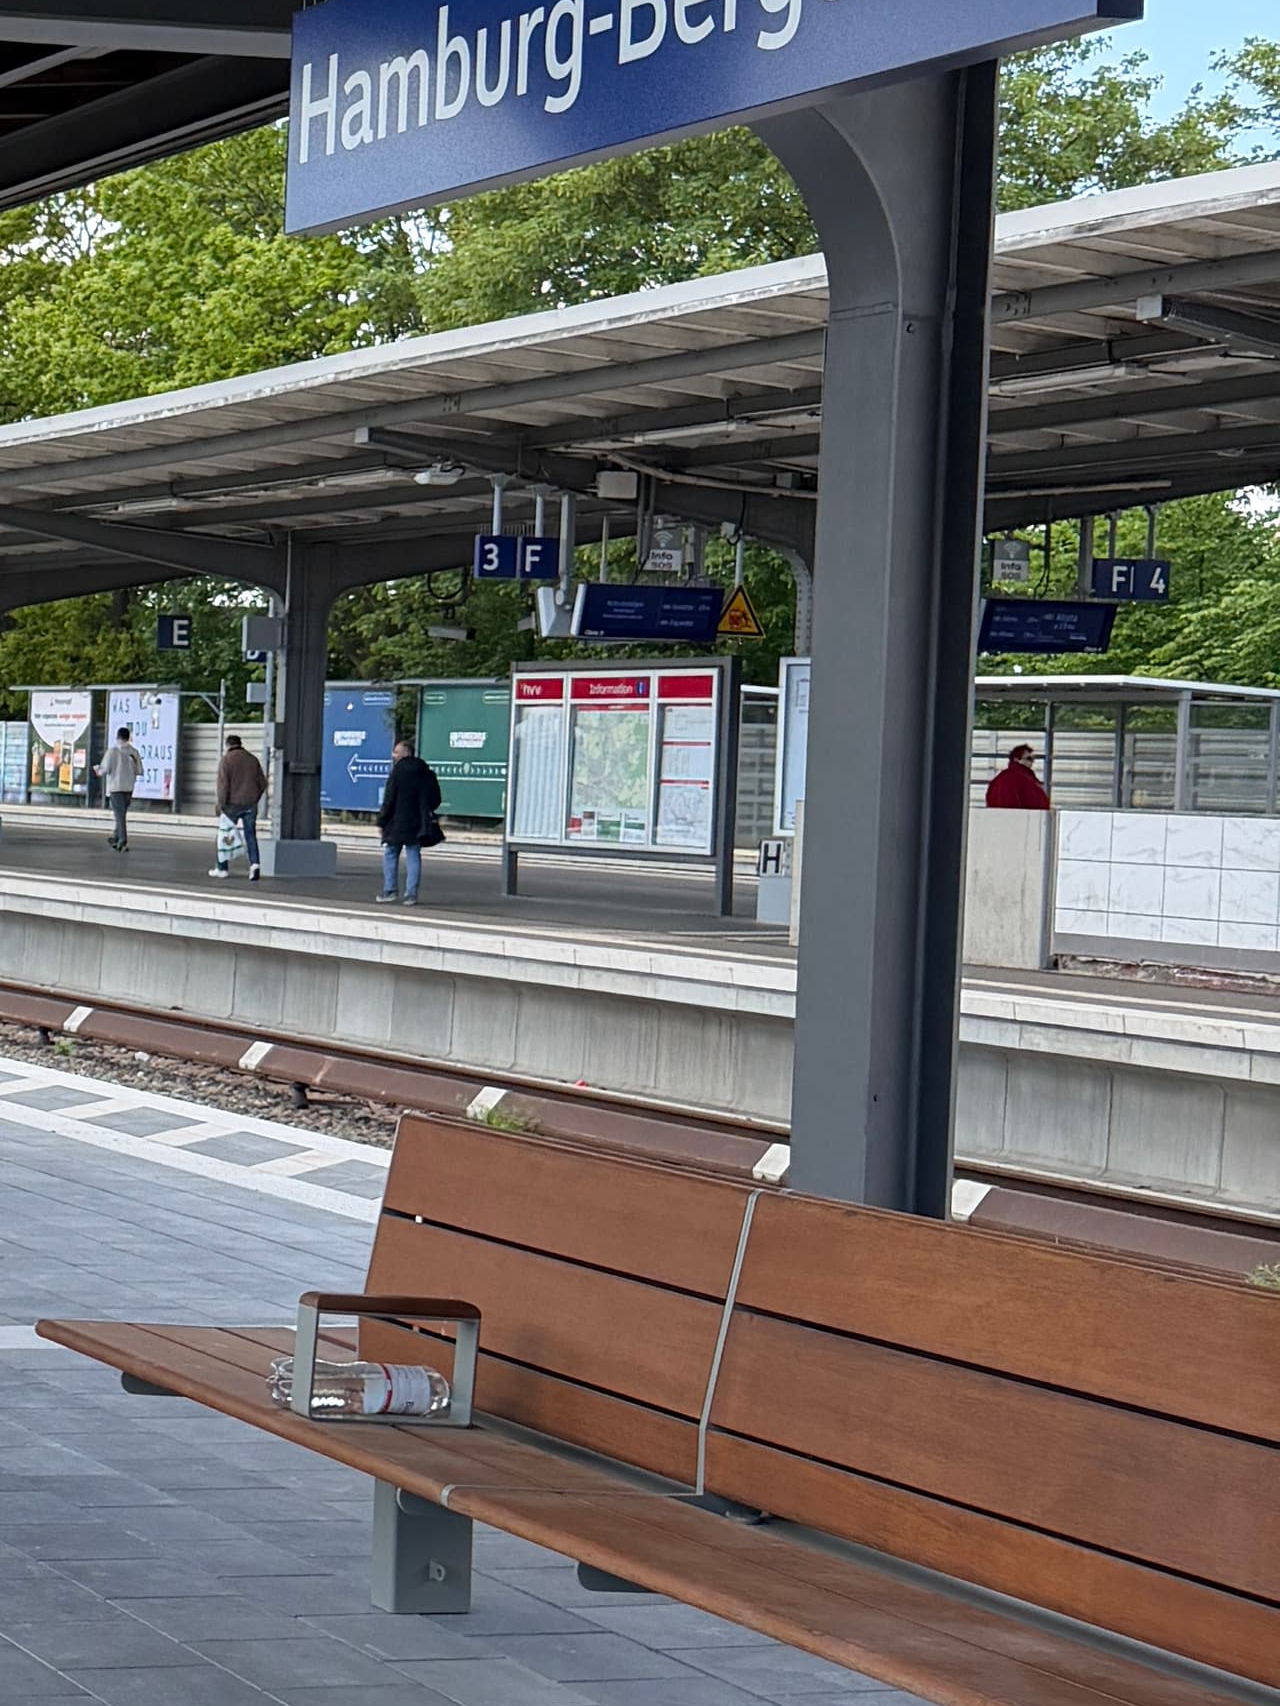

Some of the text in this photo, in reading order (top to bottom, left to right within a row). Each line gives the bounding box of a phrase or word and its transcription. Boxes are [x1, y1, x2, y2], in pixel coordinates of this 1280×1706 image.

[482, 543, 542, 572] 3 F
[651, 551, 673, 561] Info
[1001, 562, 1022, 571] Info
[1111, 565, 1166, 594] F 4
[172, 619, 189, 646] E
[589, 683, 634, 695] Information
[763, 843, 781, 873] H
